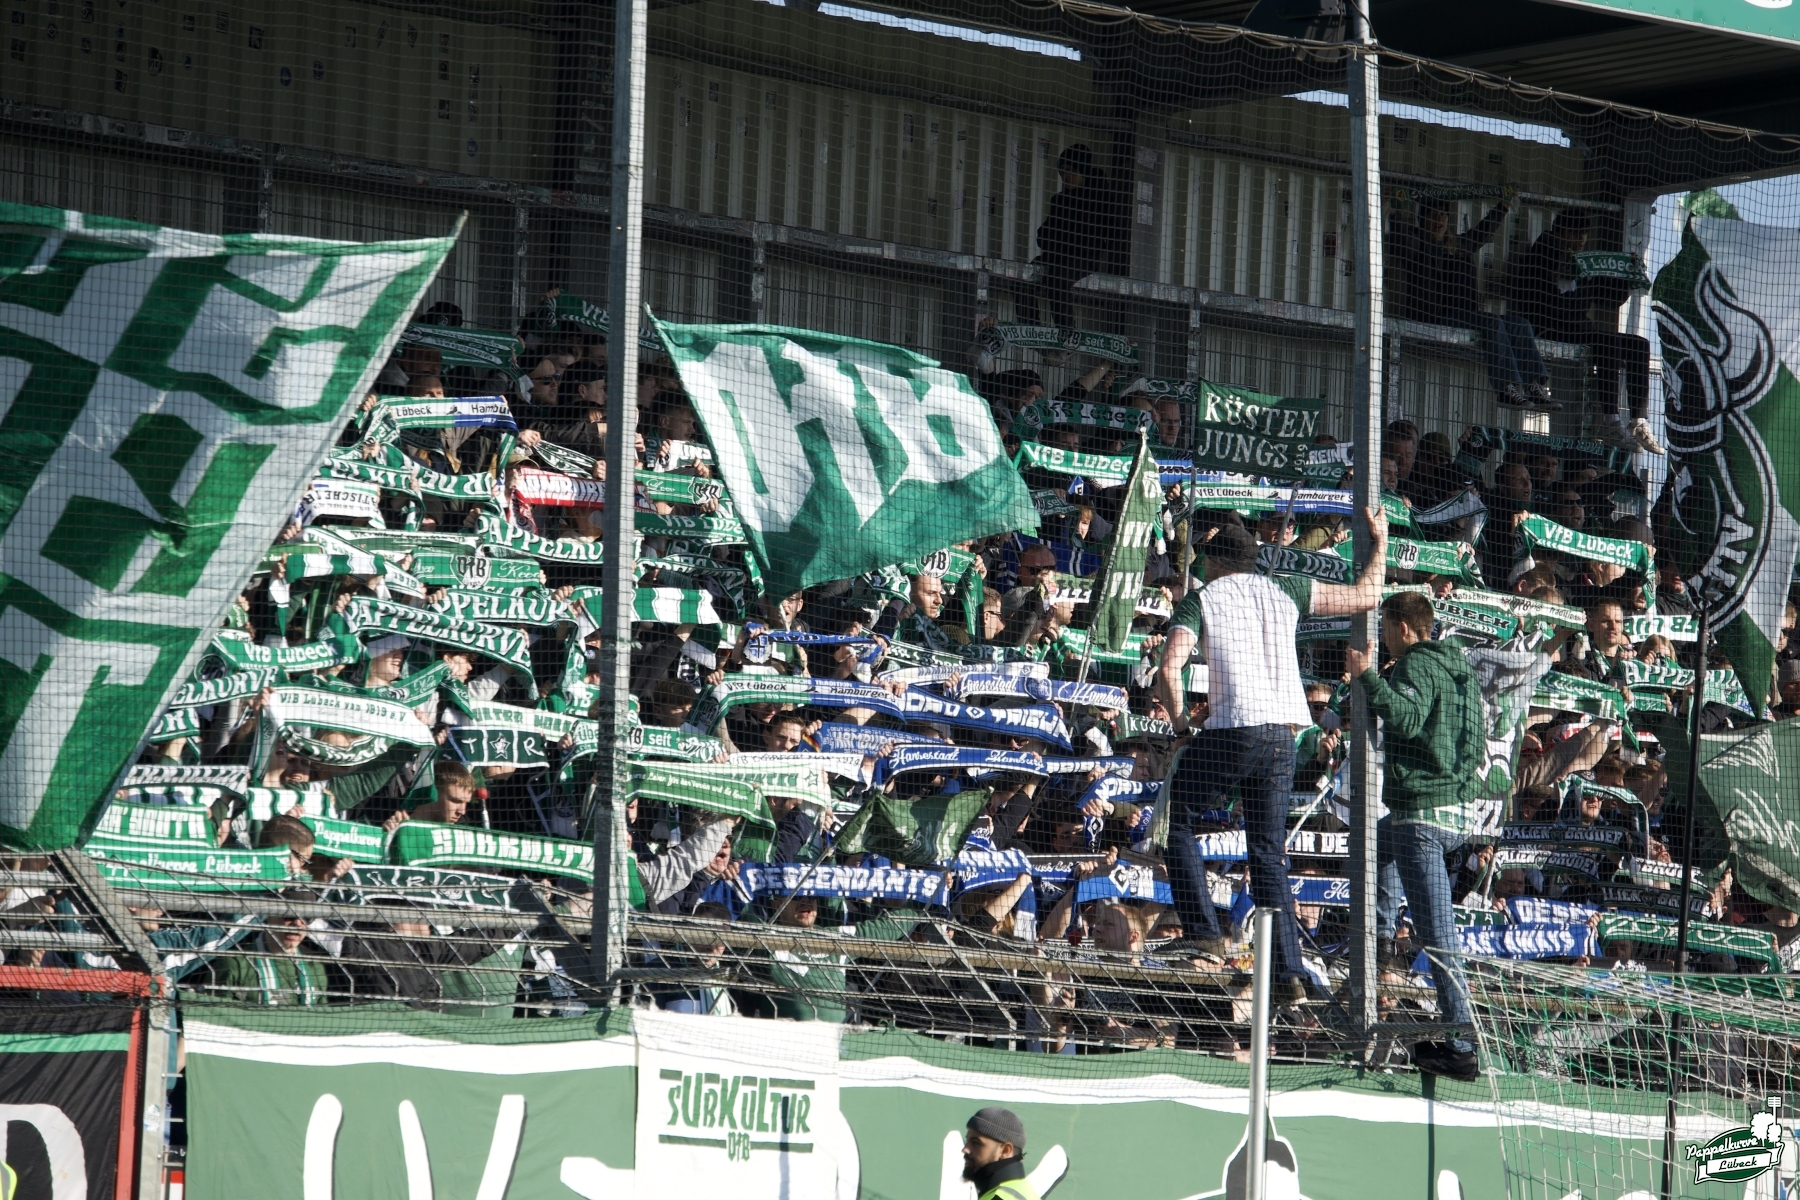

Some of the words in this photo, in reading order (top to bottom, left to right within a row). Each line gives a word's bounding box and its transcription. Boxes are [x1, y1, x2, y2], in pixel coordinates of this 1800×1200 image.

[1020, 326, 1057, 341] Lübeck
[1085, 335, 1104, 348] seit
[1110, 339, 1131, 356] 1919
[396, 404, 432, 417] Lübeck
[1204, 391, 1320, 439] KÜSTEN
[1197, 427, 1289, 469] JUNGS
[1072, 452, 1133, 474] Lübec
[325, 489, 379, 508] ATISCHE
[1217, 486, 1254, 498] Lübeck
[477, 511, 605, 563] PAPPELKU
[1543, 522, 1574, 545] VfB
[1577, 532, 1636, 559] Lübeck
[1302, 552, 1348, 582] DER
[1445, 591, 1490, 603] seatischer
[350, 598, 531, 668] PAPPELKURVE
[244, 642, 273, 663] VfB
[277, 641, 337, 664] Lübeck
[175, 665, 279, 705] ELKURVE
[1626, 660, 1695, 687] APPE
[746, 680, 787, 691] Lübeck
[829, 686, 891, 700] Hamburger
[280, 691, 301, 704] VfB
[303, 693, 342, 709] Lübeck
[365, 702, 388, 719] 1919
[649, 732, 671, 747] seit
[313, 820, 382, 850] Pappelkurve
[1564, 827, 1624, 846] BRÜDER
[203, 854, 262, 876] Lübeck
[745, 866, 942, 899] DESCENDANTS
[666, 1072, 812, 1135] SUBKULTUR
